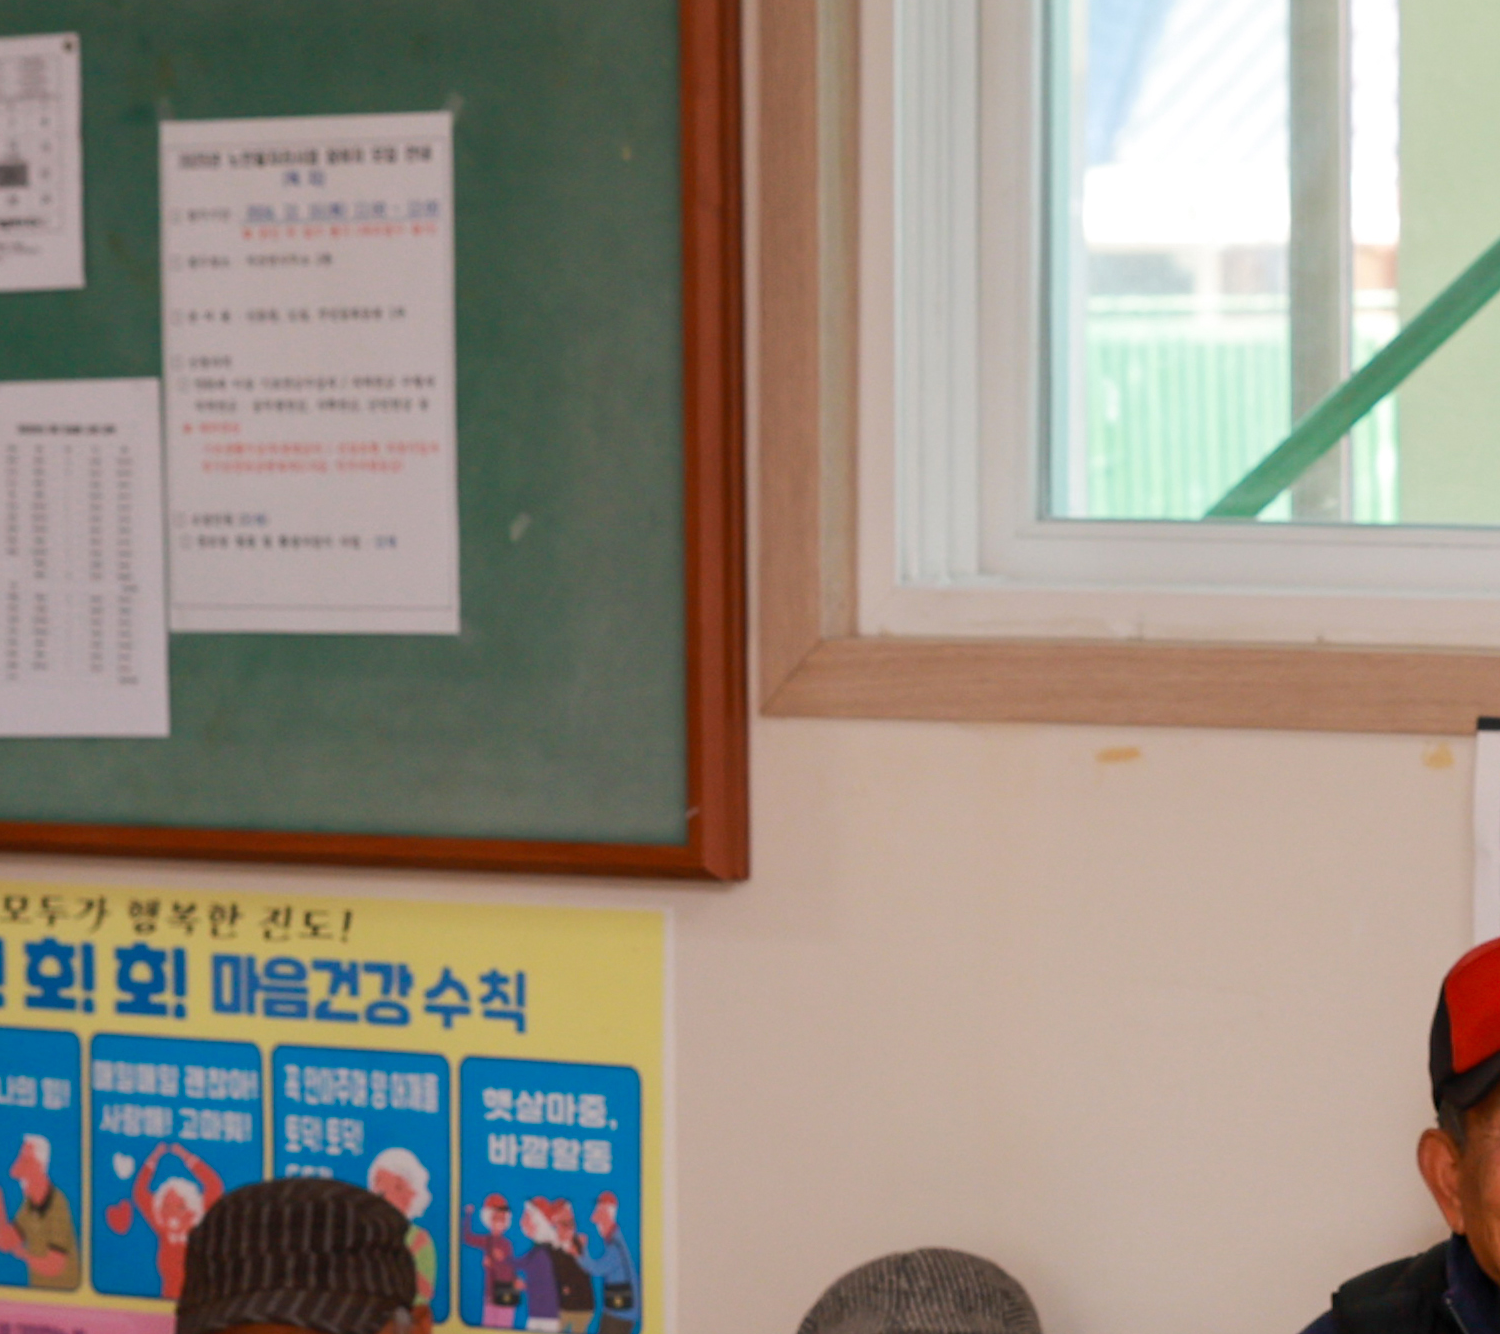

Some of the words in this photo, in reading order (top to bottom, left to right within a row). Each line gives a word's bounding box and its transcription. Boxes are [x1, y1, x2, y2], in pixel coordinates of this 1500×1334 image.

[2, 895, 110, 930] 모두가
[128, 900, 242, 940] 행복한
[260, 907, 353, 942] 진도!
[212, 954, 413, 1027] 마음건강
[424, 968, 527, 1034] 수칙
[482, 1087, 618, 1131] 햇살마중,
[487, 1133, 613, 1174] 바깥활동
